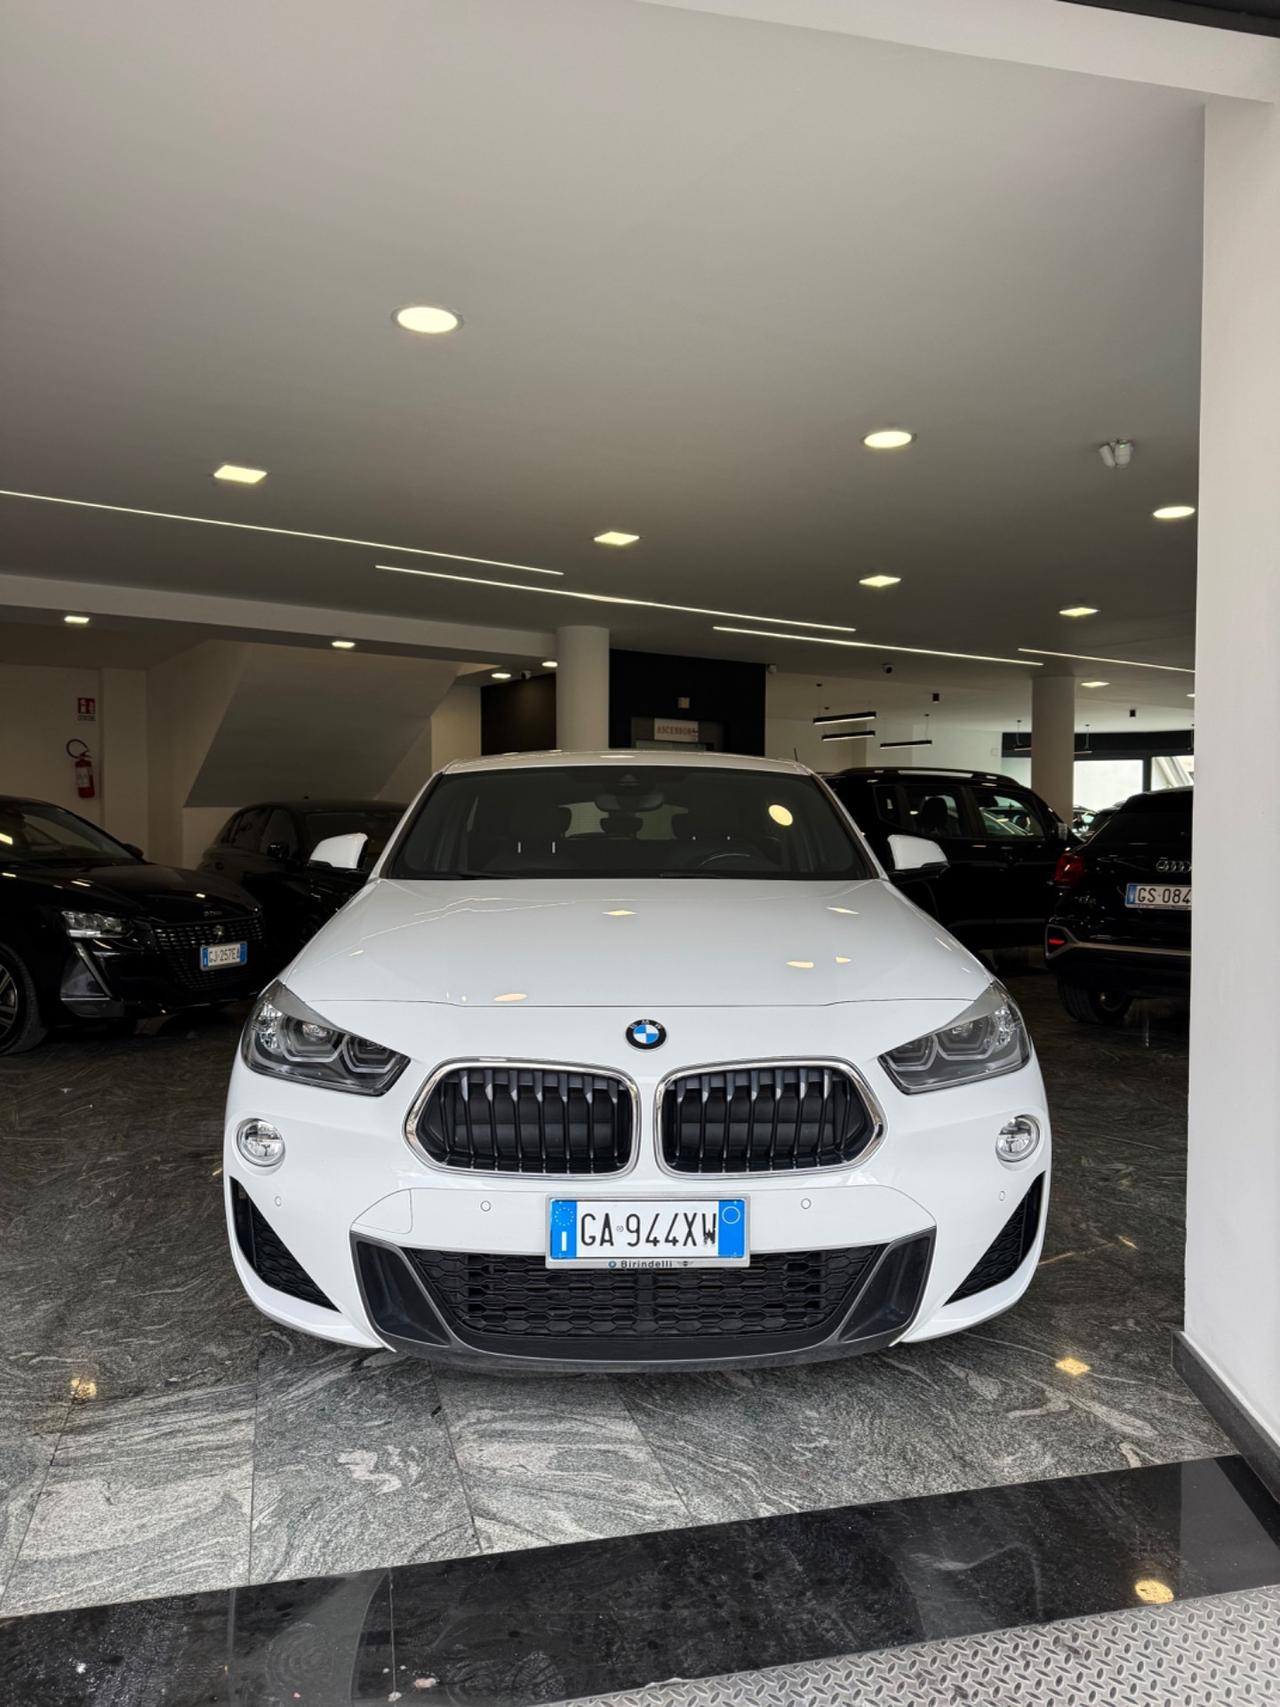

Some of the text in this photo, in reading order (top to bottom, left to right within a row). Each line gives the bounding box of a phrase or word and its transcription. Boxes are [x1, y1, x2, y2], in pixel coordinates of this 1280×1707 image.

[1137, 887, 1156, 902] GS
[1162, 888, 1191, 904] 084
[581, 1212, 716, 1247] GA 944XW
[620, 1260, 673, 1268] Birindelli
